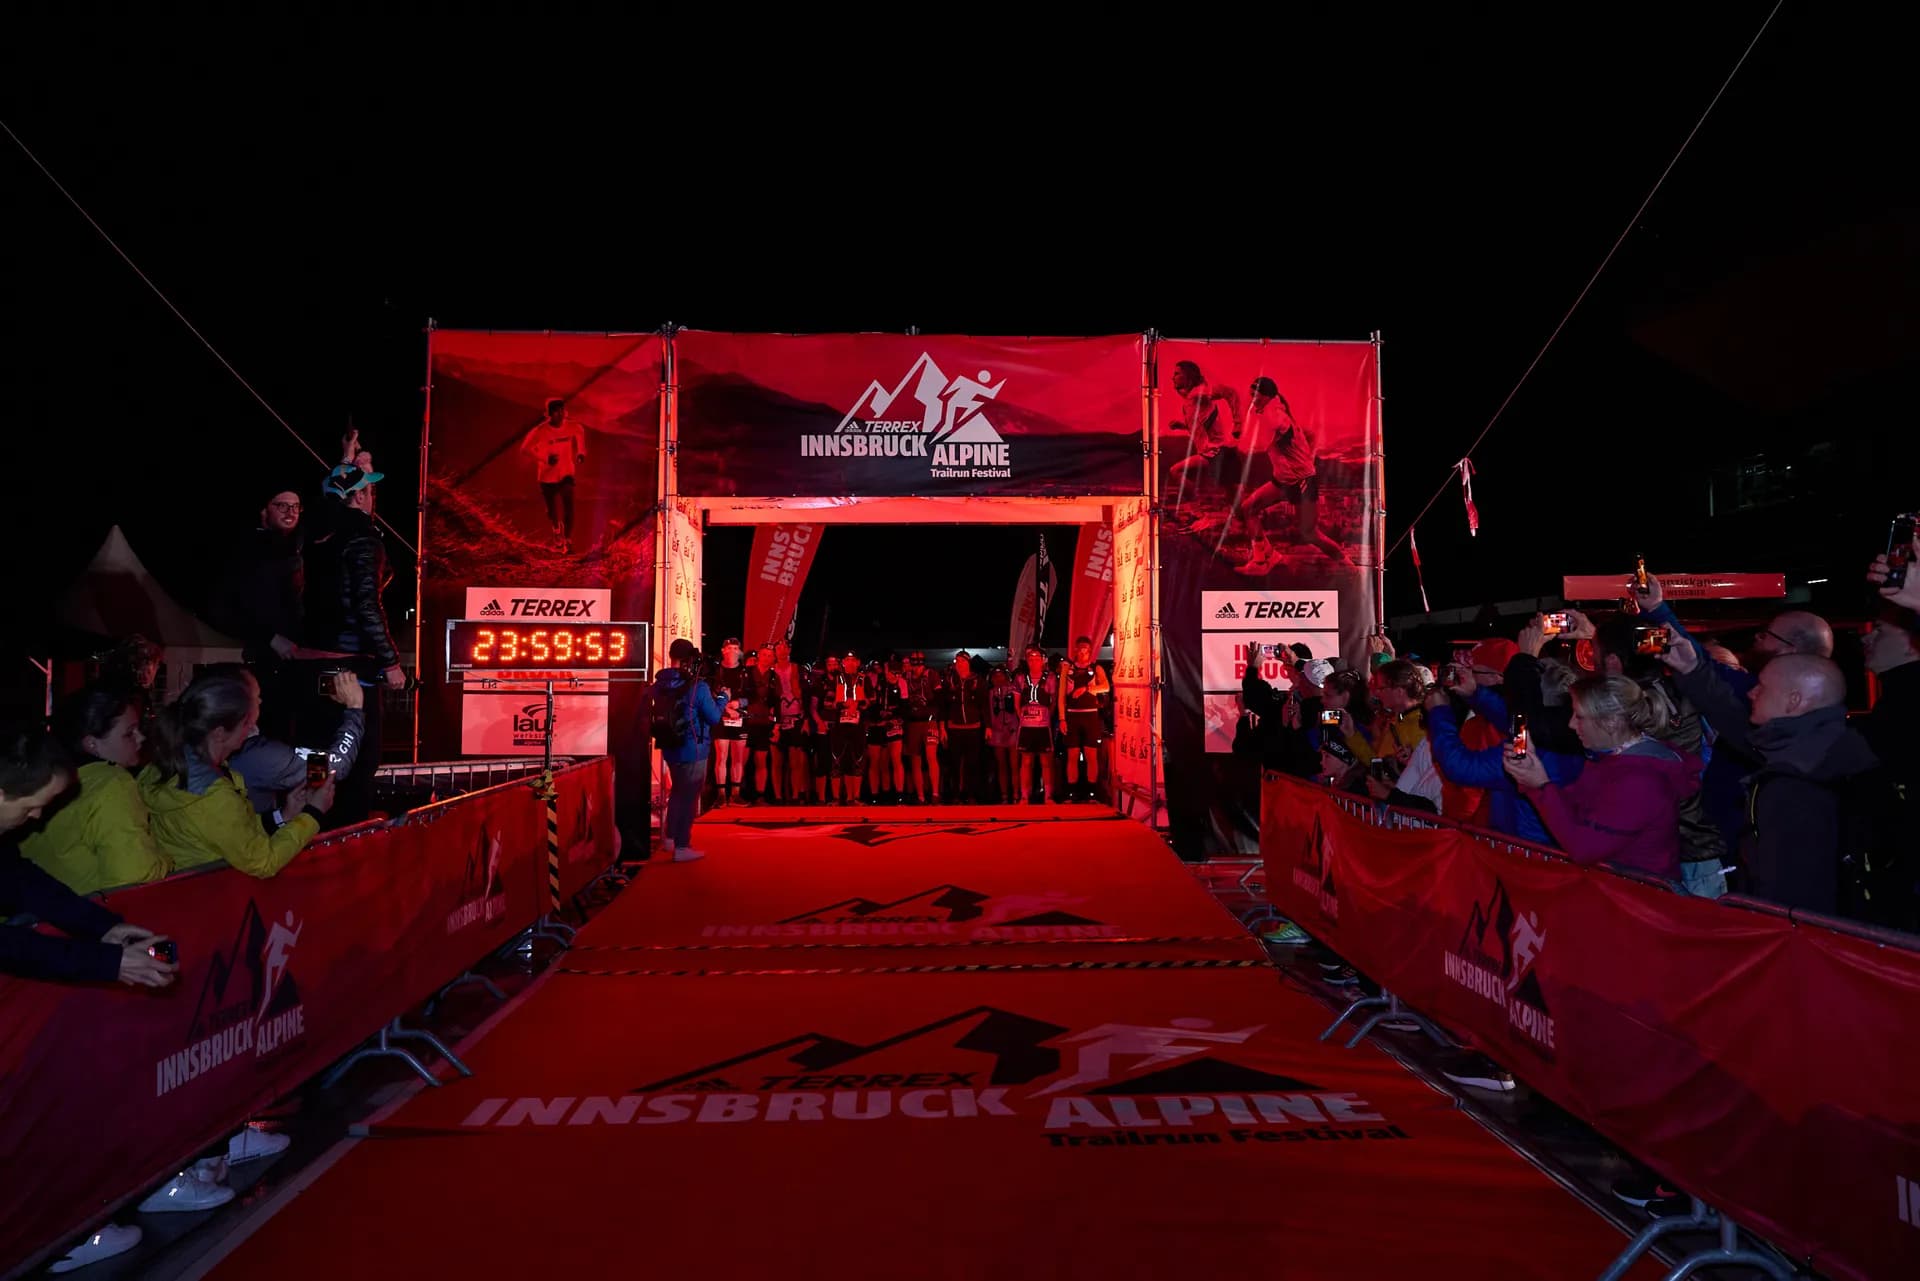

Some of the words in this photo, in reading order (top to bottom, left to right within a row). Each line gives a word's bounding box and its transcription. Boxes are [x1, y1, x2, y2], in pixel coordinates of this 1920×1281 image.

[864, 420, 922, 433] TERREX
[800, 434, 928, 457] INNSBRUCK
[931, 443, 1010, 466] ALPINE
[930, 467, 970, 478] Trailrun
[971, 467, 1011, 478] Festival
[510, 599, 596, 617] TERREX
[1244, 601, 1324, 618] TERREX
[471, 629, 627, 662] 23:59:53
[1444, 949, 1506, 1008] INNSBRUCK
[156, 1016, 254, 1097] INNSBRUCK
[256, 1004, 305, 1057] ALPINE
[760, 1072, 976, 1090] TERREX
[460, 1088, 1017, 1127] INNSBRUCK
[1044, 1091, 1386, 1129] ALPINE
[1042, 1130, 1223, 1147] Trailrun
[1229, 1125, 1409, 1143] Festival
